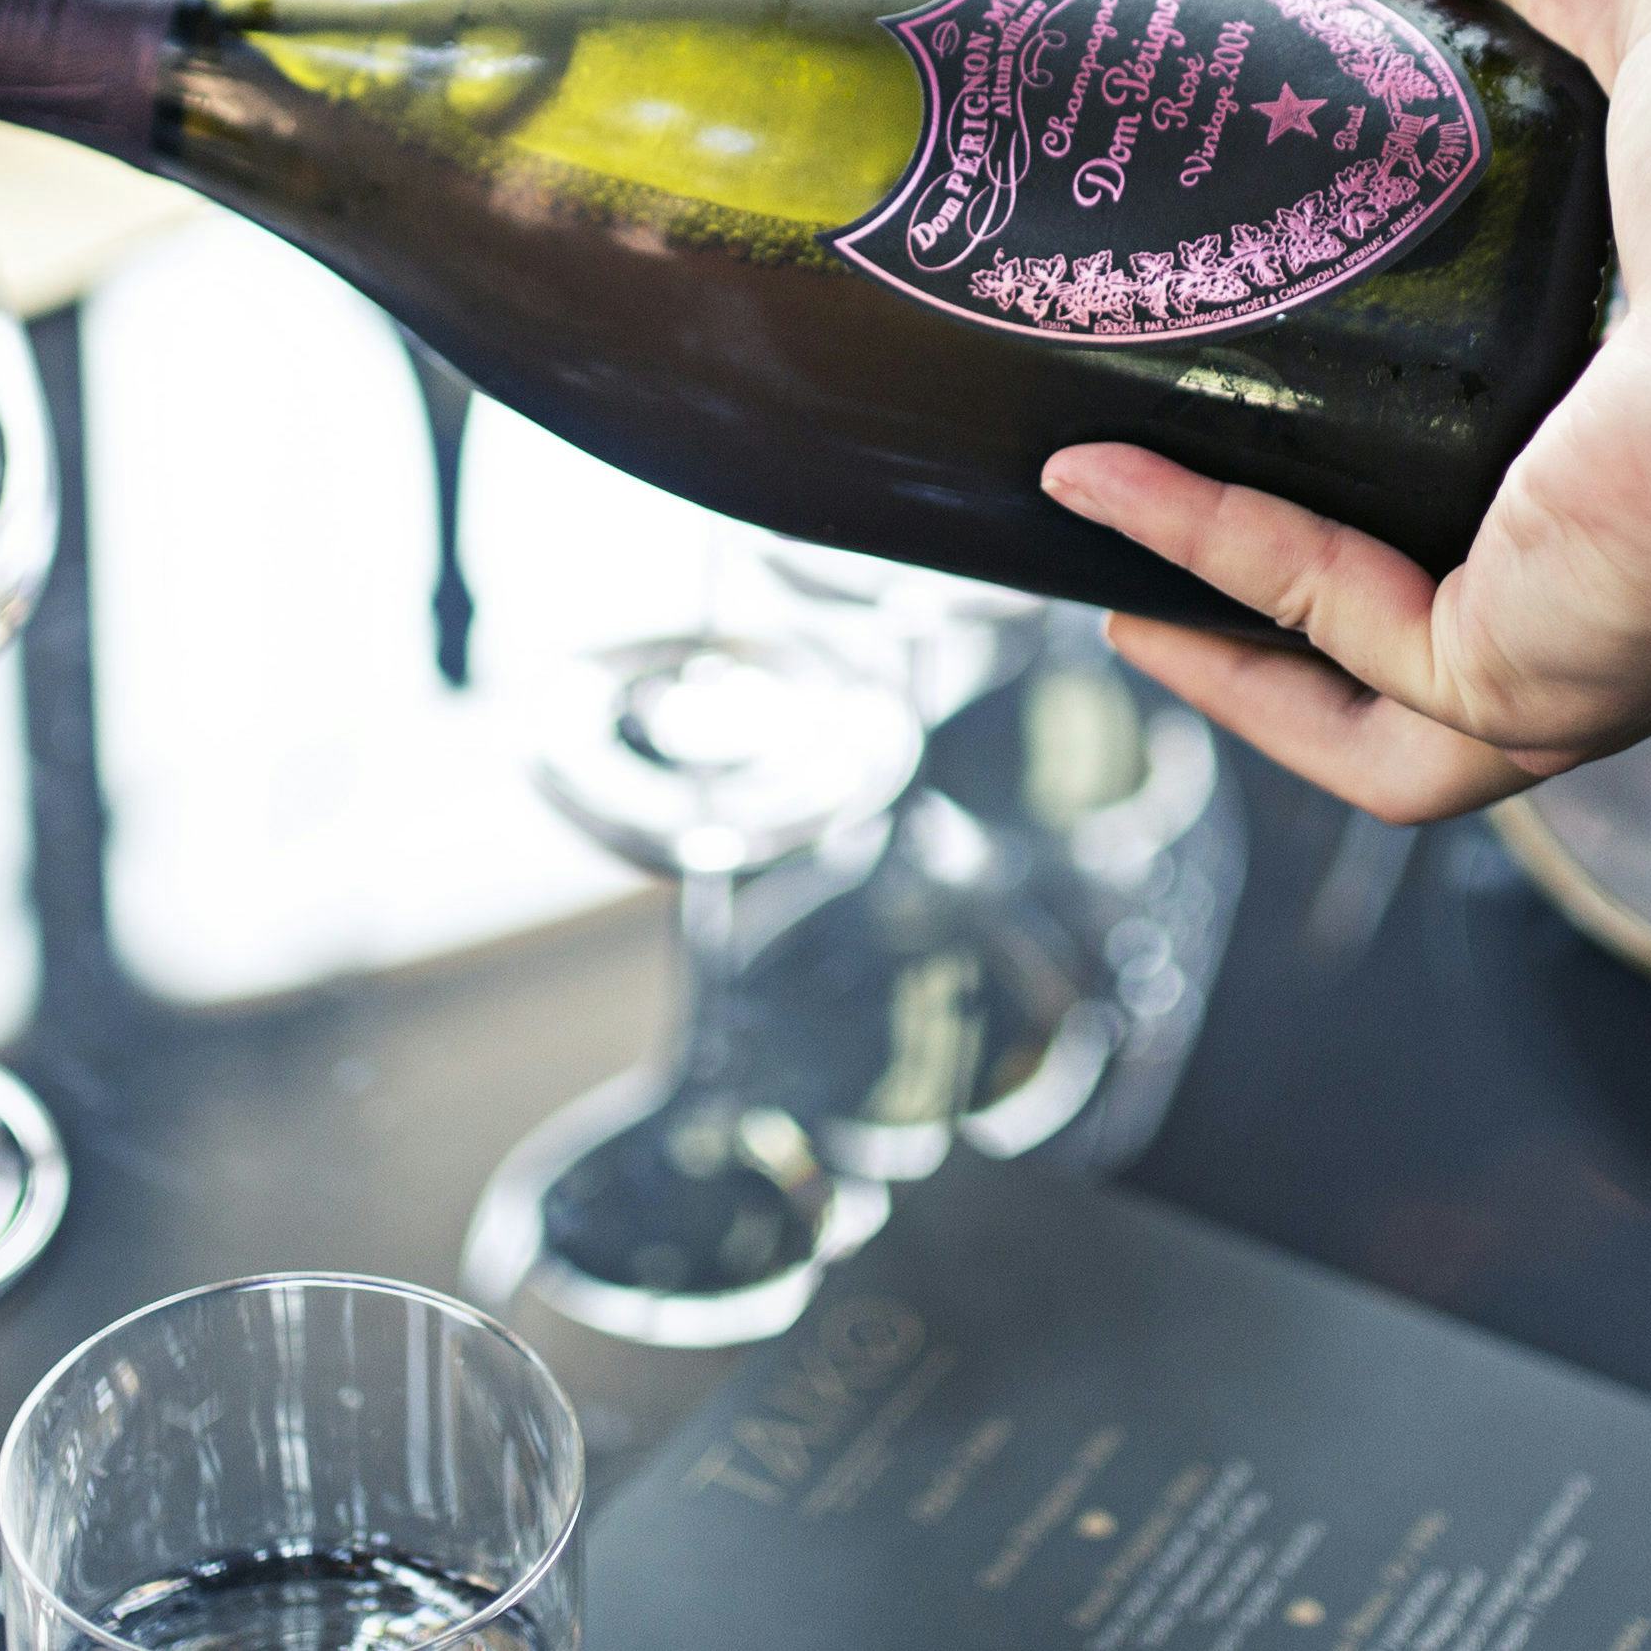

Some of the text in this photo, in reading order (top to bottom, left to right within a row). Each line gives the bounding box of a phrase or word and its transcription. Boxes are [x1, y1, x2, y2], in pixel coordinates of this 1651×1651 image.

[991, 54, 1014, 117] Altum
[1151, 52, 1205, 131] Rosé
[1179, 20, 1255, 187] Vintage 2004
[1072, 112, 1142, 207] Dom
[1334, 105, 1366, 151] Brut
[911, 196, 964, 251] Dom
[1144, 319, 1165, 332] PAR
[1167, 306, 1235, 330] CHAMPAGNE
[1279, 269, 1335, 300] CHANDON
[1389, 201, 1426, 236] FRANCE
